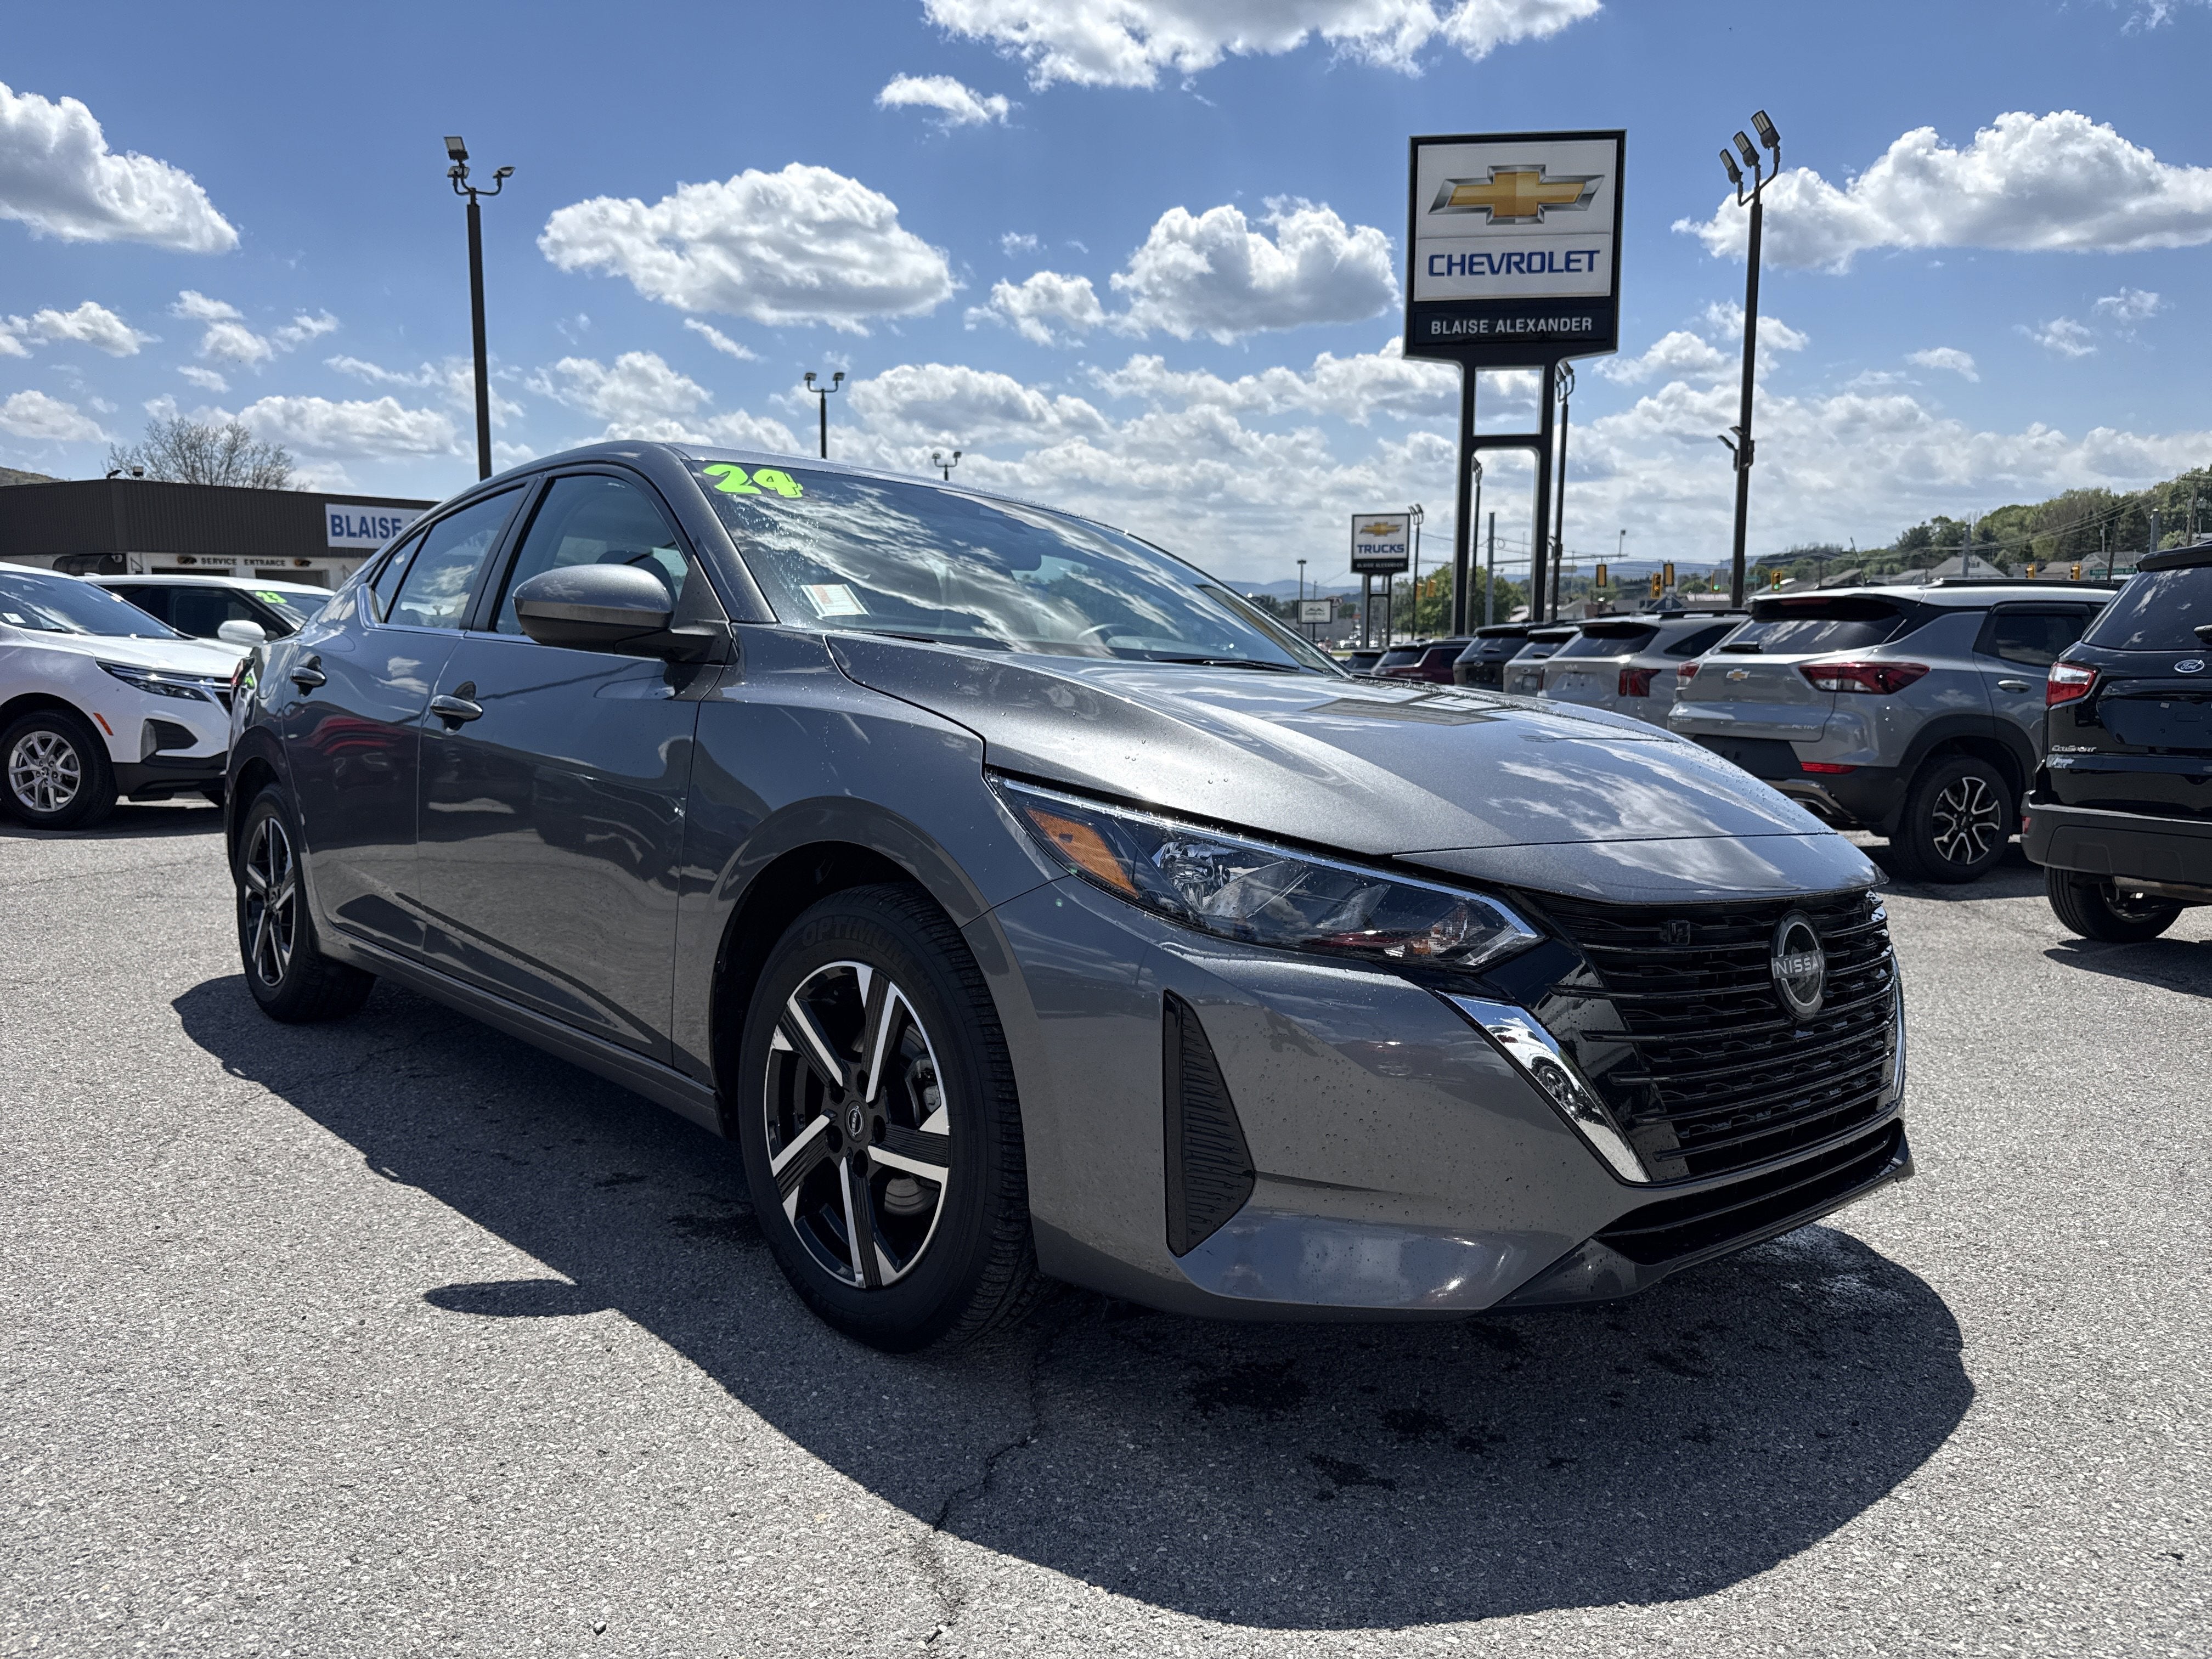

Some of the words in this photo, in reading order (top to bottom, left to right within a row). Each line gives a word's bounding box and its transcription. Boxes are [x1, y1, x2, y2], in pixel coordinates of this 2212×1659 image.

[1428, 250, 1600, 276] CHEVROLET
[1431, 320, 1489, 335] BLAISE
[1495, 317, 1592, 333] ALEXANDER
[703, 464, 803, 498] 24
[1357, 544, 1404, 554] TRUCKS
[201, 557, 237, 565] SERVICE
[255, 591, 287, 603] 23
[802, 915, 914, 971] OPTIMUM
[1775, 953, 1825, 975] NISSAN
